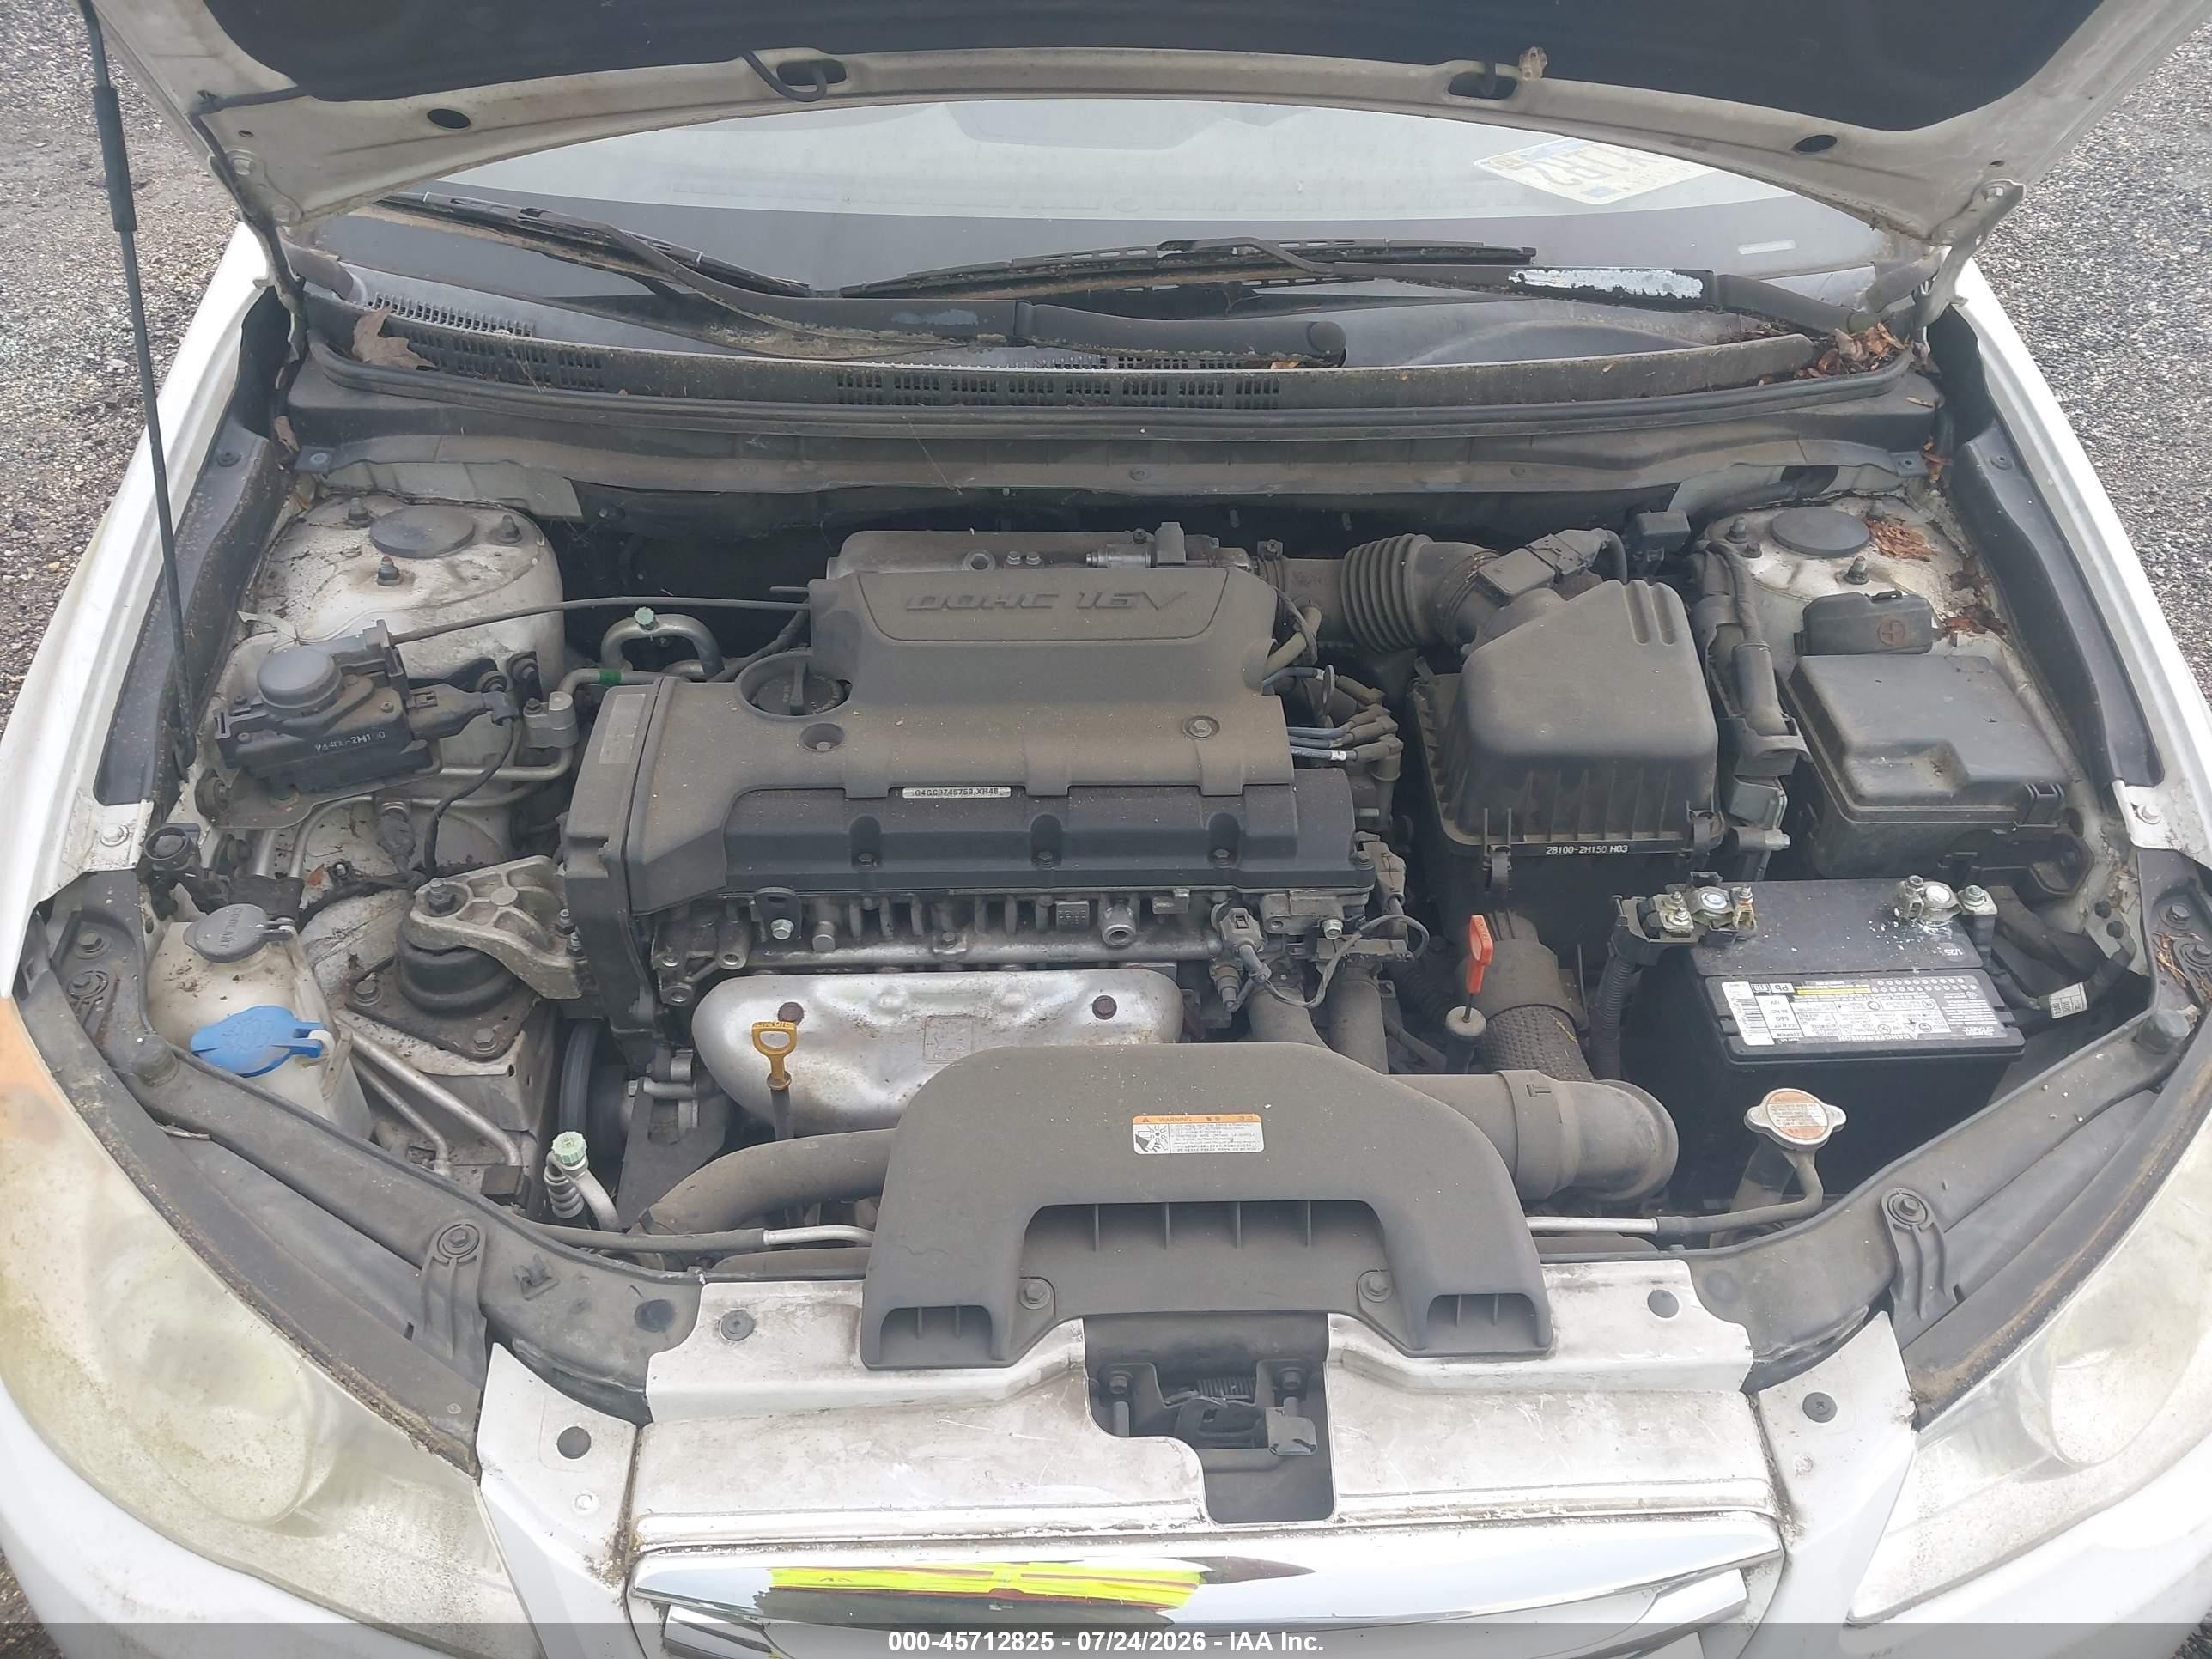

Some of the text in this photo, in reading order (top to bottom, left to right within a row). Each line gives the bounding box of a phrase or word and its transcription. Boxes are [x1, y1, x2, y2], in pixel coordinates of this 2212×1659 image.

[906, 591, 1188, 611] DOHC 16V
[1546, 844, 1629, 854] 28100-2H150 H03
[219, 907, 243, 949] COOLANT
